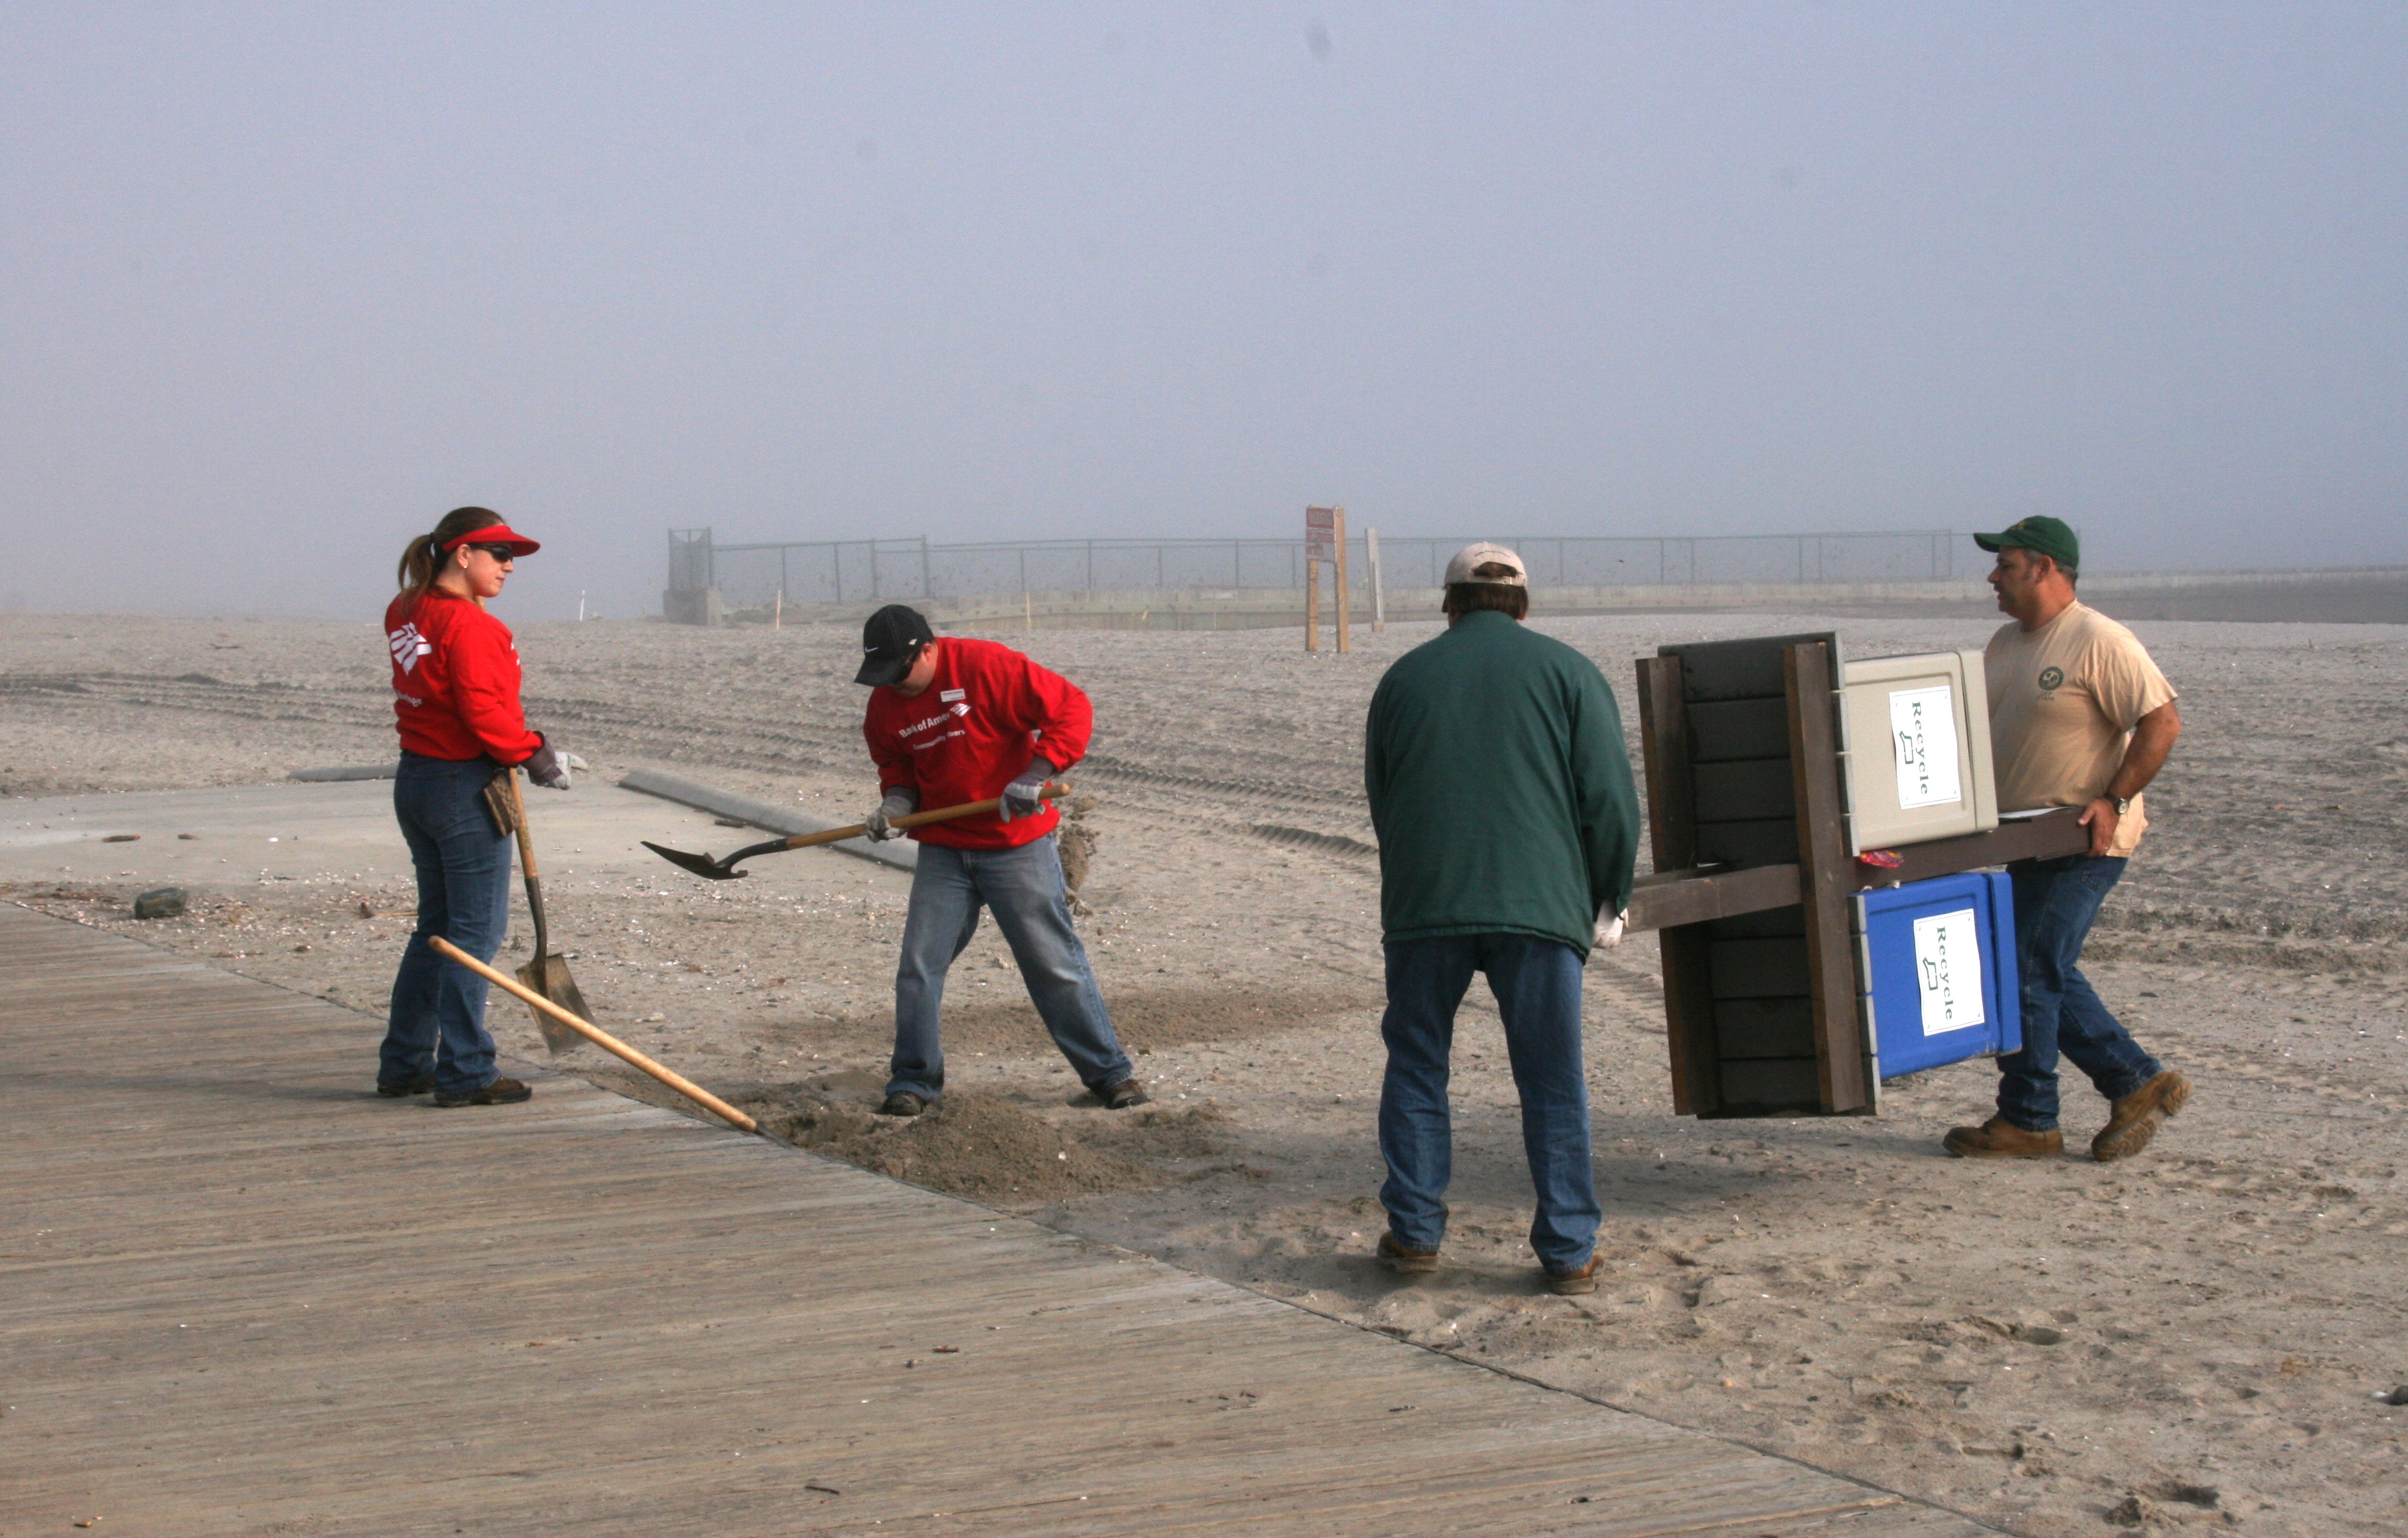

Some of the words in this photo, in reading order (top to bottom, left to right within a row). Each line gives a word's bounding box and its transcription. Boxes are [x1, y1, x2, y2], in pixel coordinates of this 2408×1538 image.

[917, 720, 927, 731] of
[1912, 701, 1928, 794] Recycle
[1937, 926, 1953, 1020] Recycle
